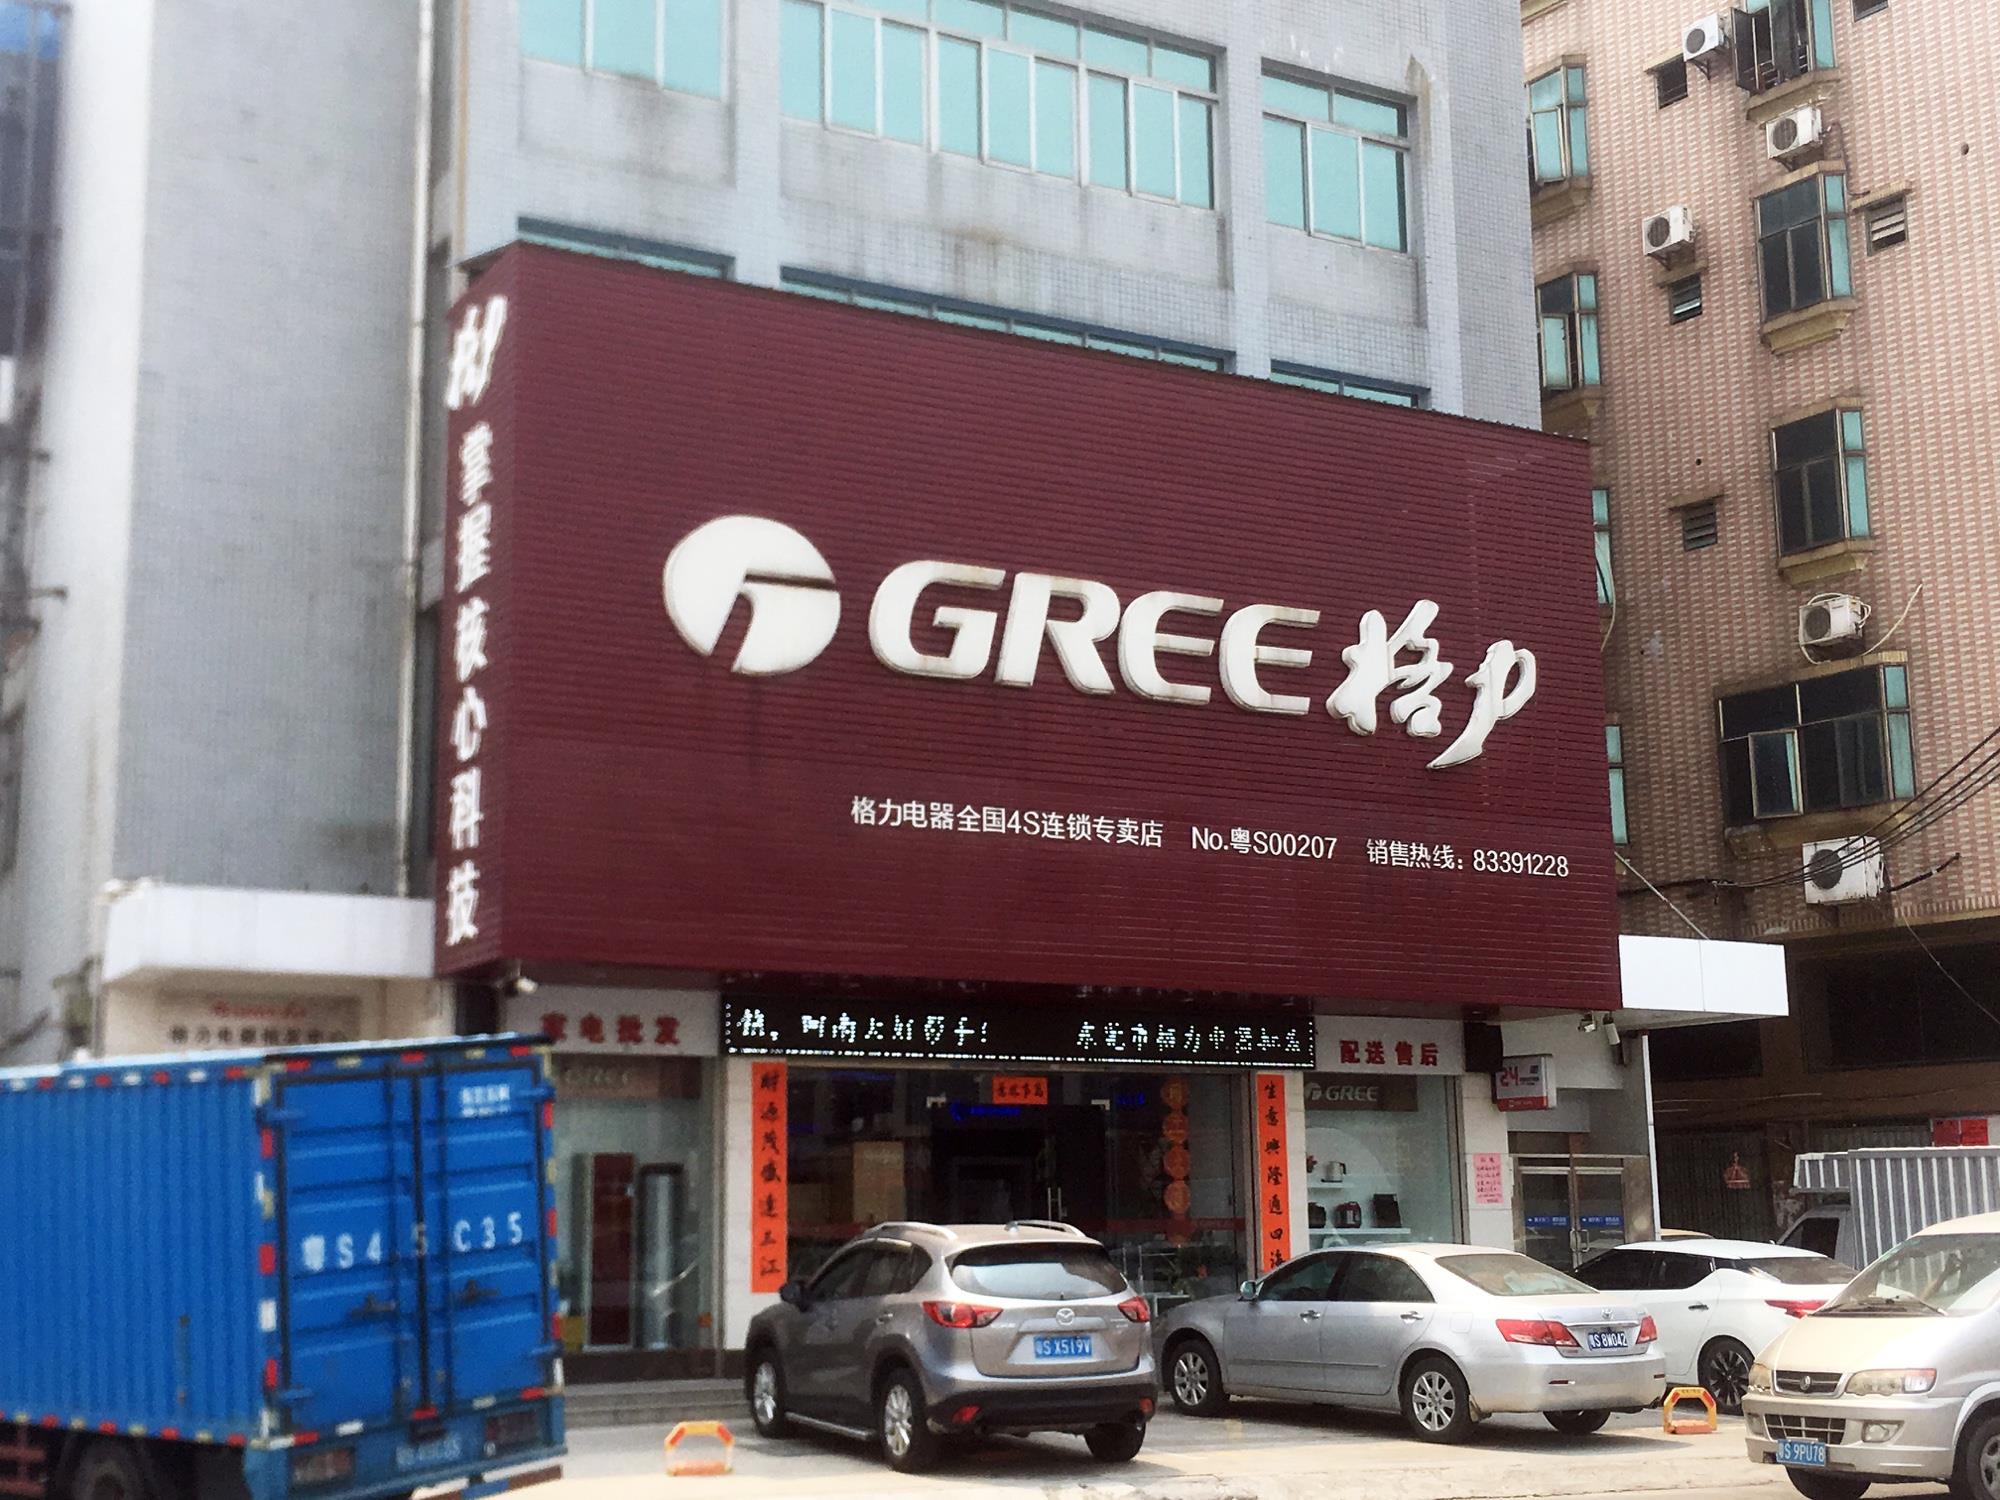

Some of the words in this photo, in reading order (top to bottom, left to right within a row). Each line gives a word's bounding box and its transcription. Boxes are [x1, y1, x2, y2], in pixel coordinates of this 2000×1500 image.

[868, 560, 1321, 716] GREE
[1326, 599, 1537, 769] 格力
[446, 420, 494, 946] 掌握核心科技
[851, 796, 1164, 849] 格力电器全国4S连锁专卖店
[1190, 827, 1338, 861] No.粤S00207
[540, 1011, 681, 1045] 家电批发
[1339, 1040, 1439, 1067] 配送售后
[1325, 1085, 1379, 1101] GREE
[1500, 1065, 1519, 1087] 24
